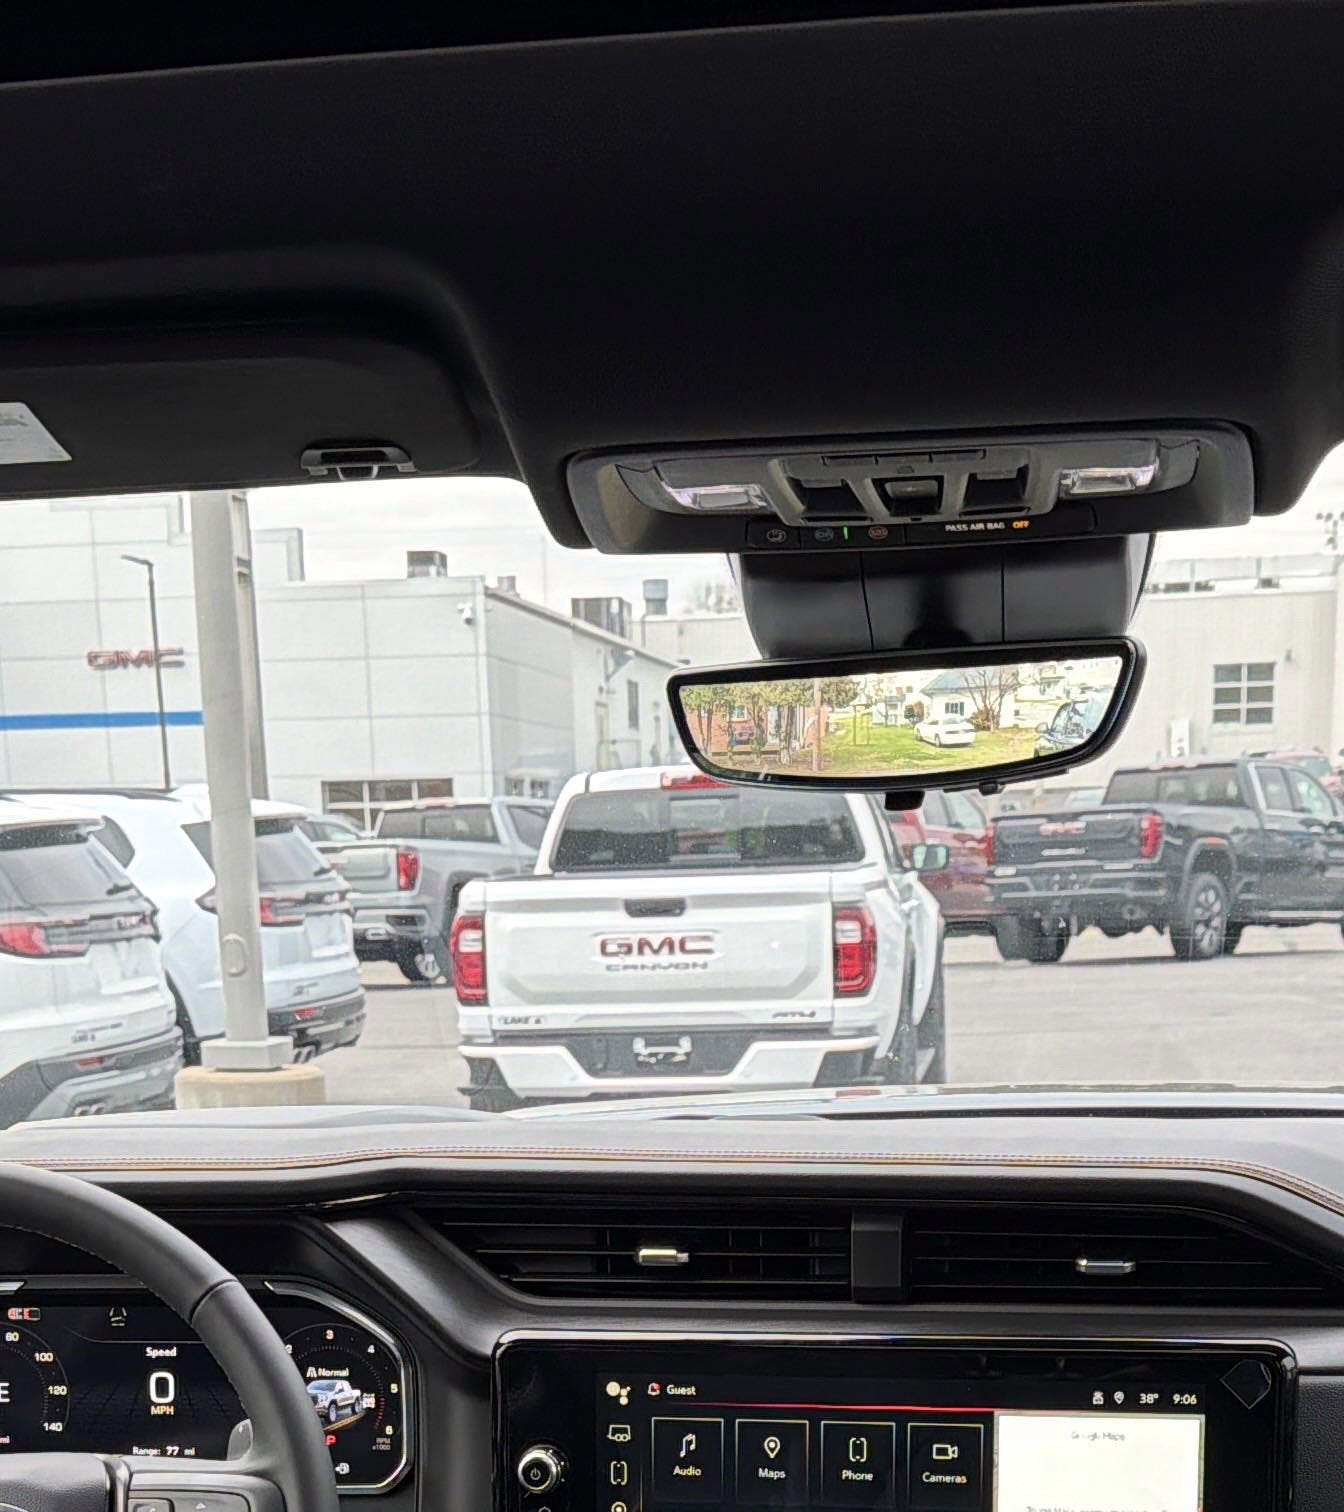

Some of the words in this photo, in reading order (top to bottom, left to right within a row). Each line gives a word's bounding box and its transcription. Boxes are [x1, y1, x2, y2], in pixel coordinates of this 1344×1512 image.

[945, 524, 968, 532] PASS
[970, 523, 985, 531] AIR
[987, 522, 1005, 530] BAG
[1012, 520, 1030, 529] OFF
[86, 648, 184, 671] GMC
[600, 935, 715, 958] GMC
[605, 961, 708, 973] CANYON
[6, 1332, 19, 1342] 80
[326, 1330, 334, 1339] 3
[146, 1347, 177, 1358] Speed
[367, 1345, 375, 1354] 4
[35, 1353, 54, 1362] 100
[318, 1368, 349, 1377] Normal
[48, 1386, 67, 1395] 120
[391, 1384, 398, 1394] 5
[149, 1371, 175, 1403] 0
[667, 1385, 696, 1396] Guest
[1139, 1393, 1159, 1404] 38°
[1173, 1394, 1197, 1405] 9:06
[150, 1405, 174, 1416] MPH
[43, 1423, 63, 1432] 140
[386, 1425, 393, 1435] 6
[325, 1435, 336, 1446] P
[132, 1446, 161, 1456] Range:
[166, 1446, 179, 1456] 77
[184, 1446, 195, 1456] mi
[673, 1466, 701, 1477] Audio
[758, 1468, 786, 1480] Maps
[842, 1470, 873, 1481] Phone
[922, 1472, 967, 1483] Cameras
